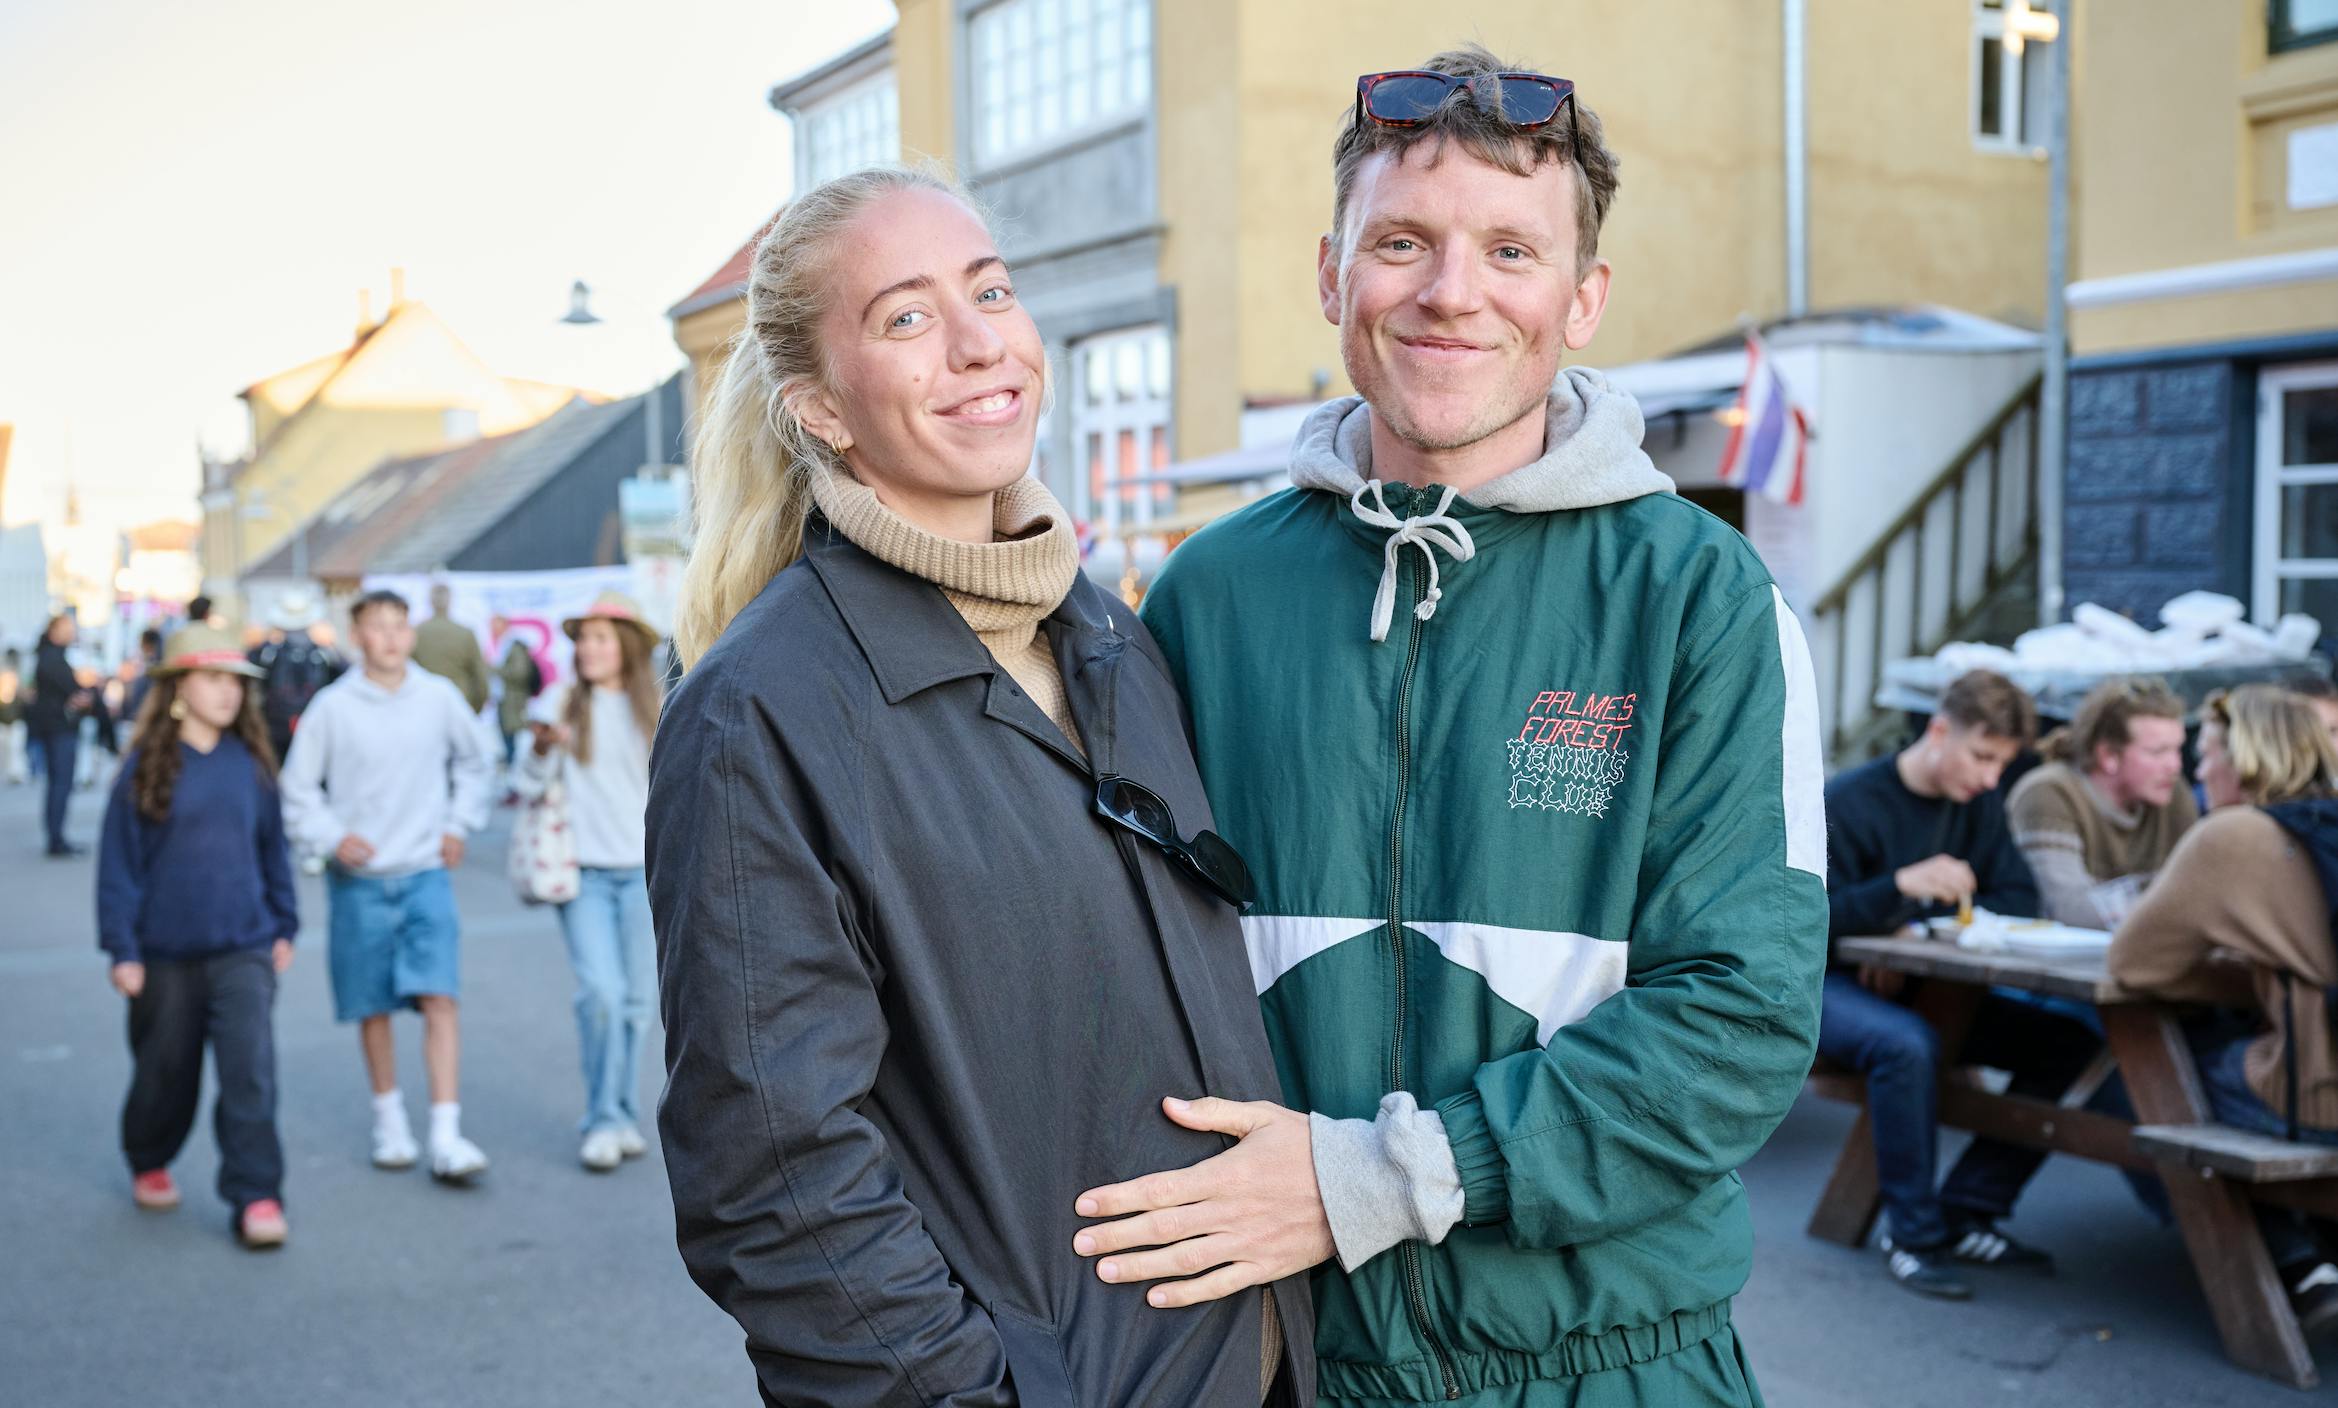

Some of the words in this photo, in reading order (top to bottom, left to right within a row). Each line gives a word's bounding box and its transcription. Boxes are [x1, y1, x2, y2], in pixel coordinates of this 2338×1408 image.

[1528, 691, 1637, 721] PALMES
[1519, 716, 1632, 749] FOREST
[1506, 738, 1629, 786] TENNIS
[1508, 771, 1613, 819] CLUB
